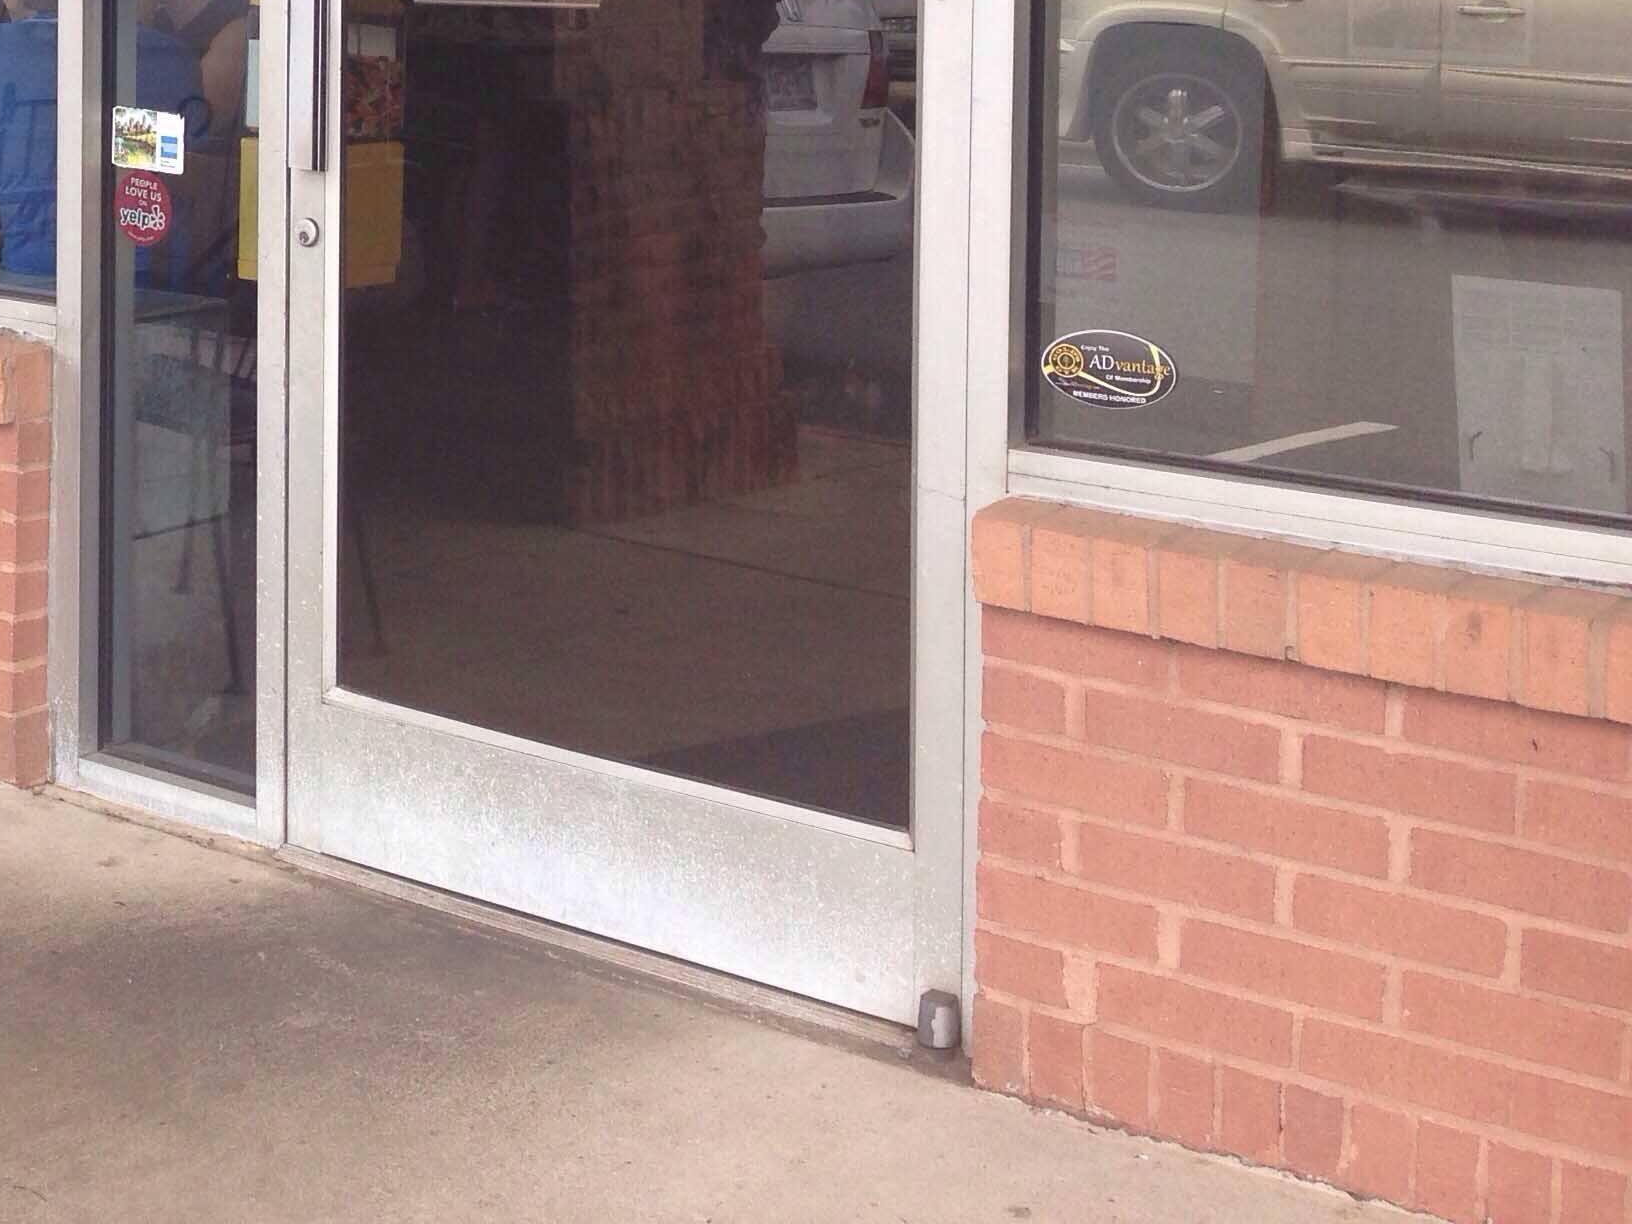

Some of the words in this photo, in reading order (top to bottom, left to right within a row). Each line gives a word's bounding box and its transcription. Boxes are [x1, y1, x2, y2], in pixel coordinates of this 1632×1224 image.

[130, 176, 158, 191] PEOPLE
[125, 185, 148, 198] LOVE
[150, 191, 162, 202] US
[120, 207, 152, 231] yelp
[1114, 374, 1152, 384] Membership
[1072, 389, 1108, 401] MEMBERS
[1109, 395, 1147, 405] HONORED
